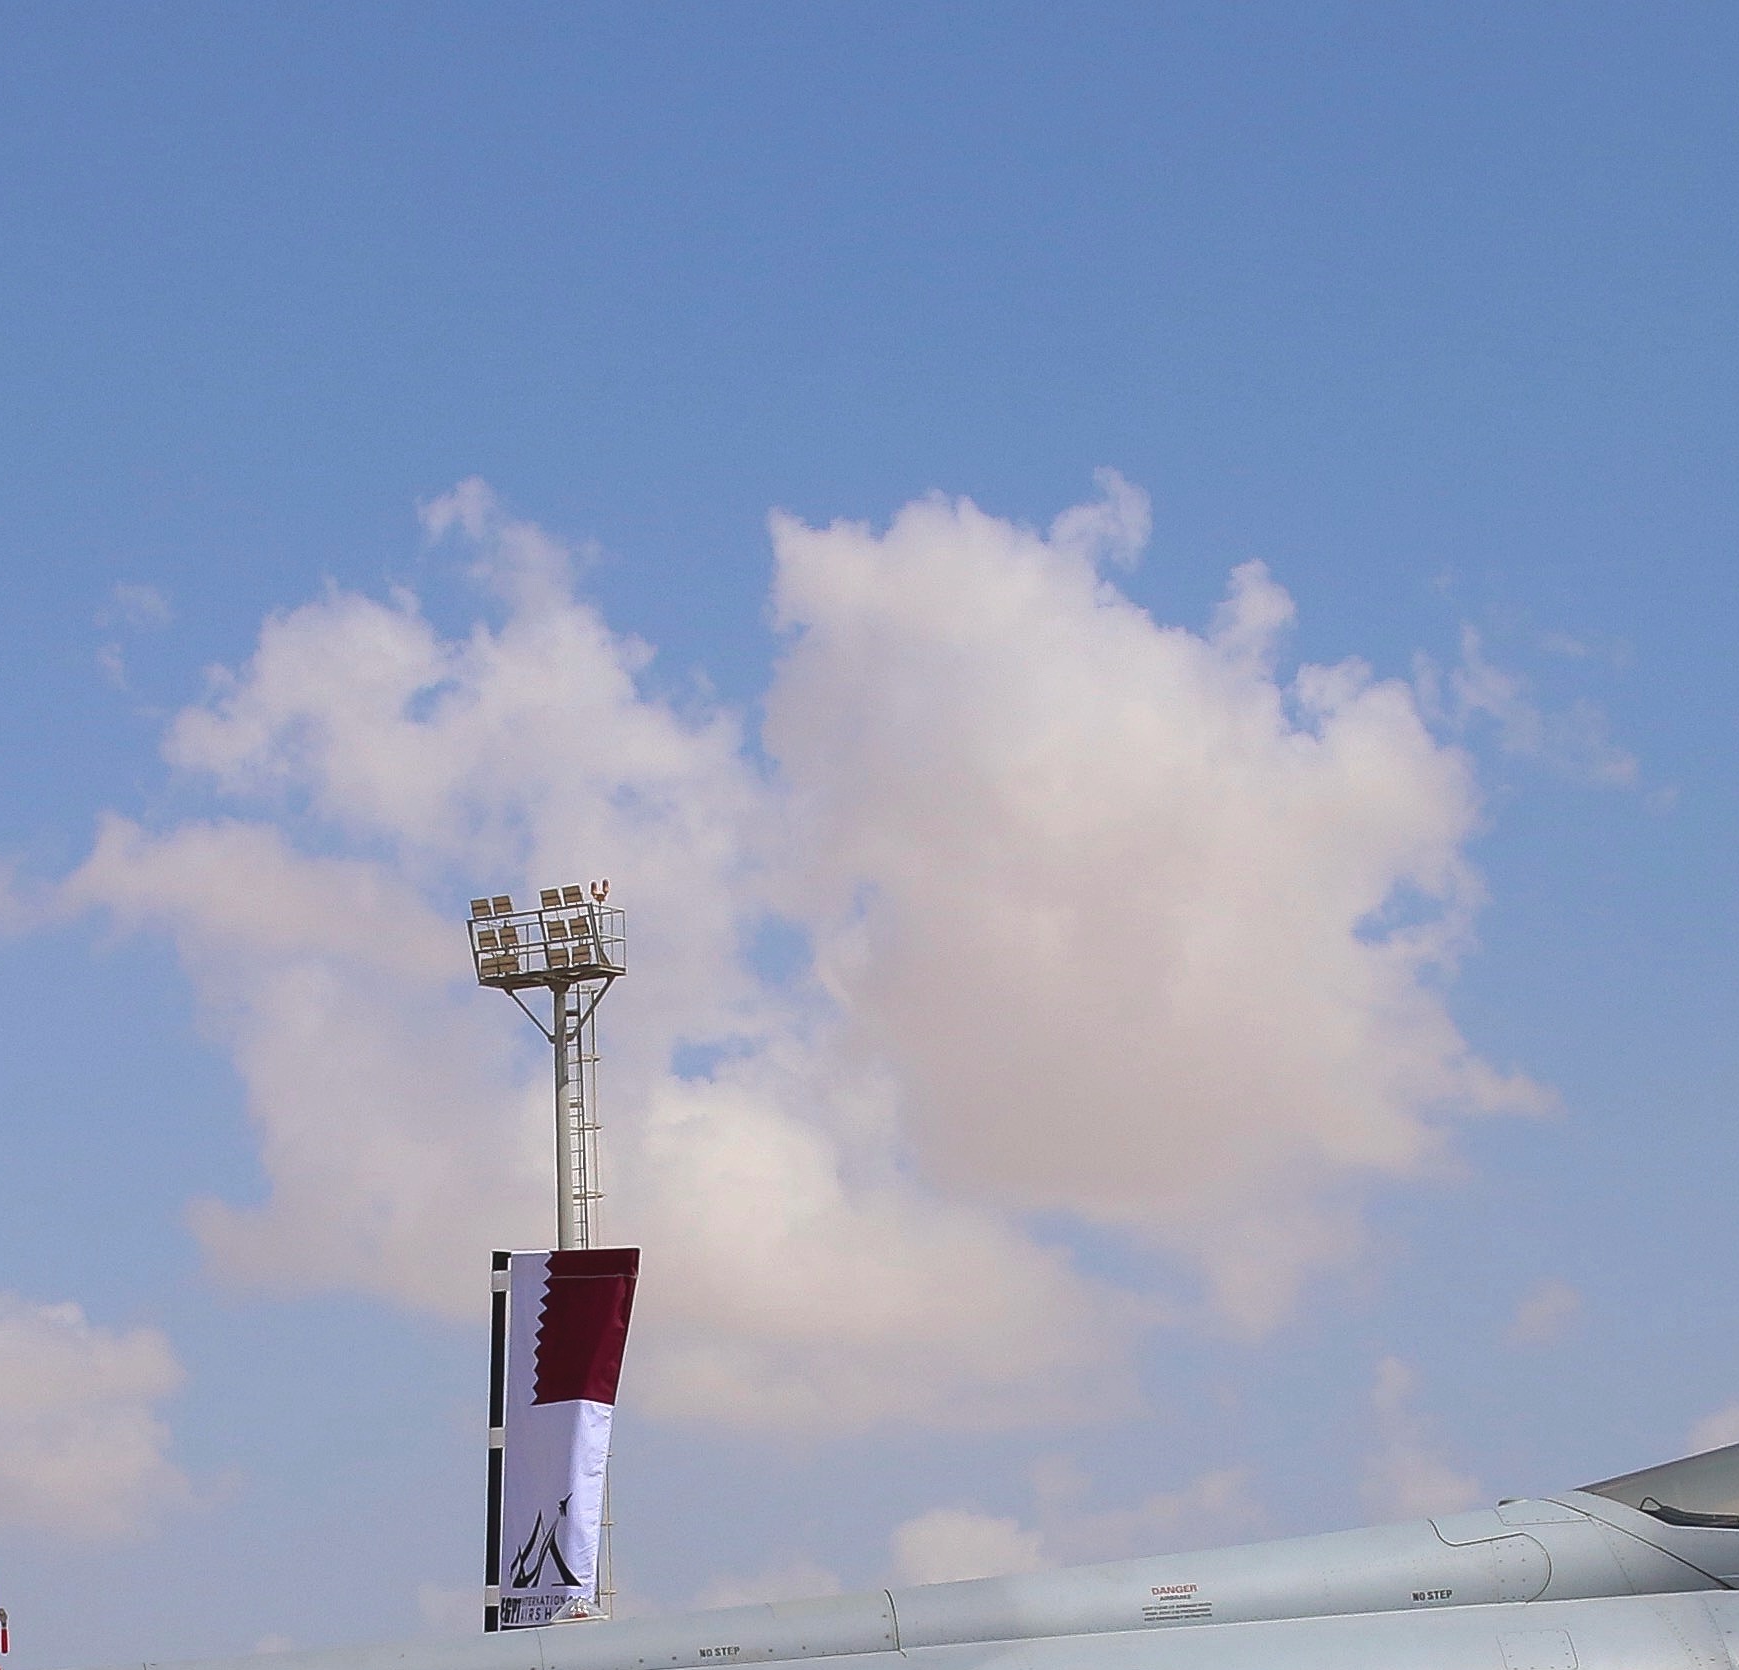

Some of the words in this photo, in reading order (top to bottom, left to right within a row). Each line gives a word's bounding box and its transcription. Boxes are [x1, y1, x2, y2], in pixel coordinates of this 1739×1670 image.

[1151, 1584, 1198, 1595] DANGER
[1412, 1592, 1425, 1601] NO
[1427, 1589, 1452, 1600] STEP
[714, 1646, 740, 1656] STEP
